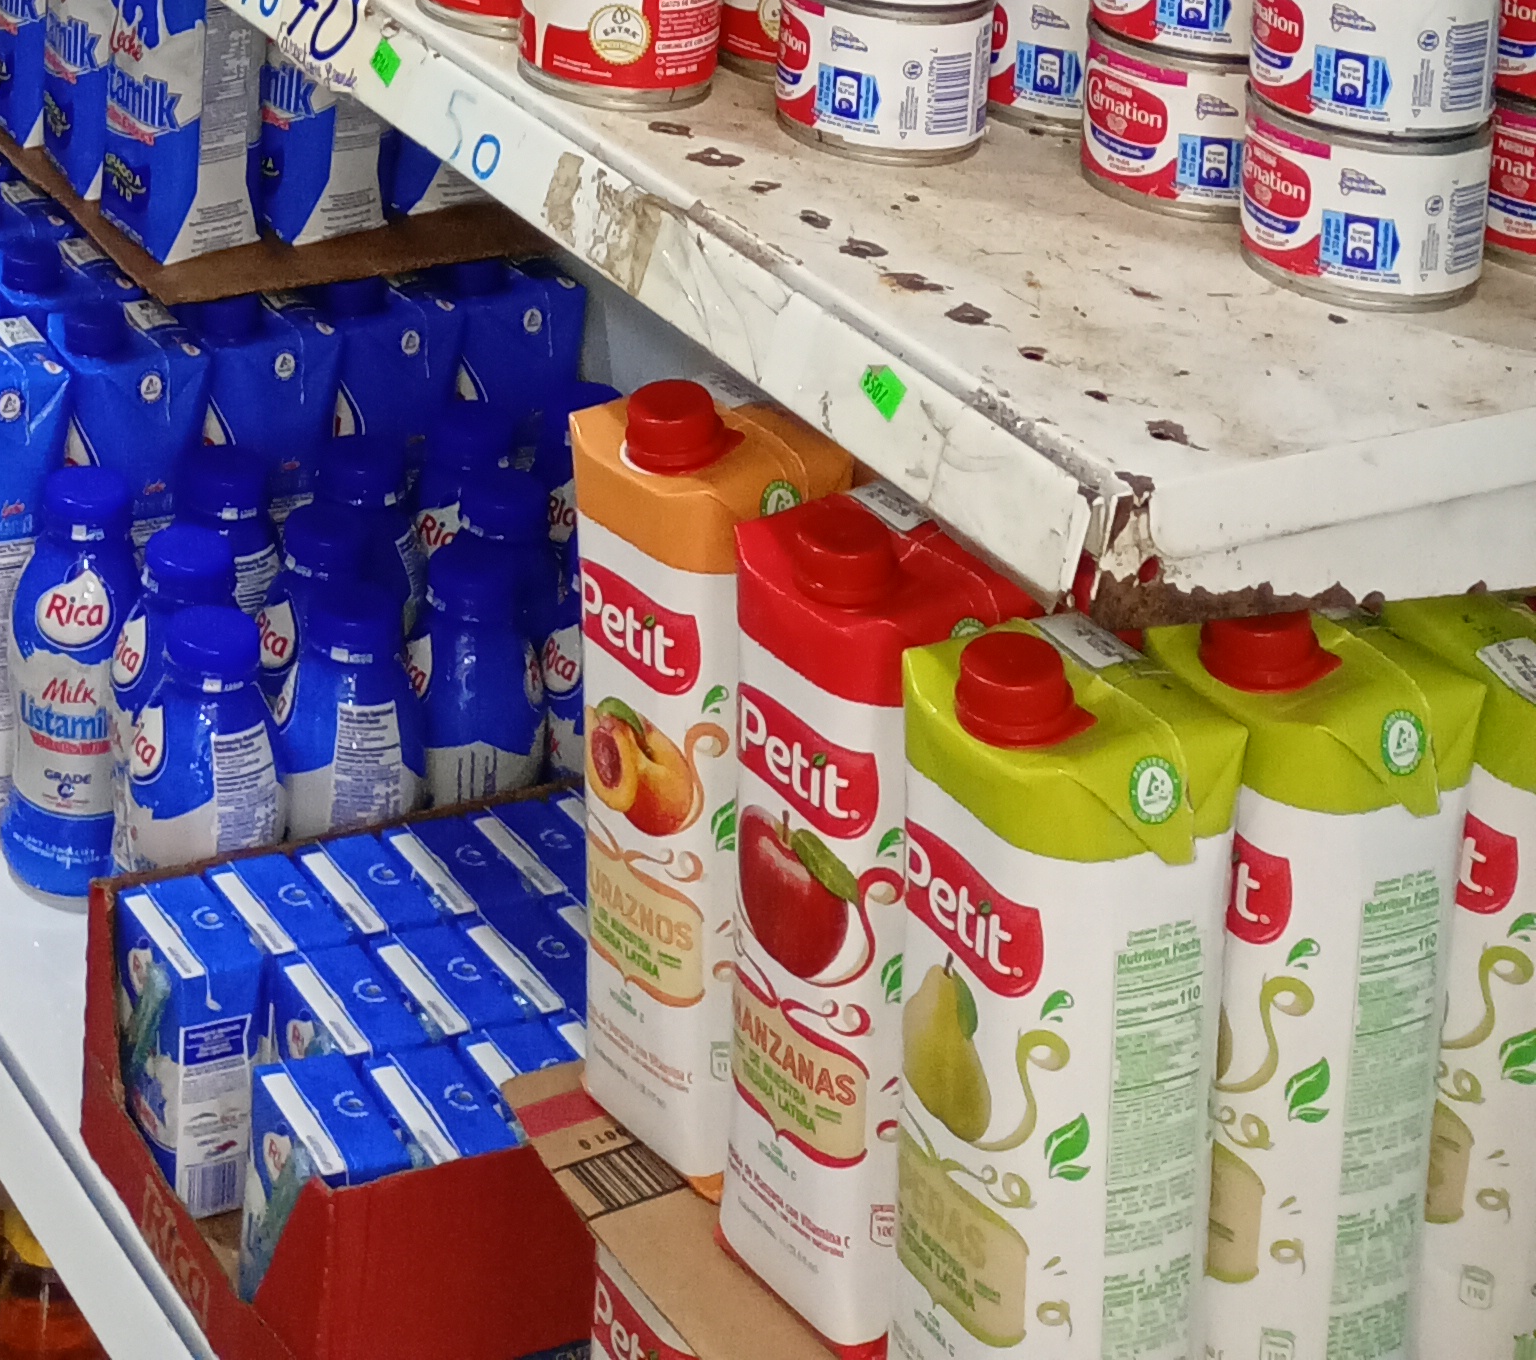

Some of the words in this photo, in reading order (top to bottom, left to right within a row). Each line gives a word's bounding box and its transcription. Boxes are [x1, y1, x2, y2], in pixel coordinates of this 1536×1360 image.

[107, 69, 183, 131] tamilk
[1088, 75, 1162, 130] Carnation
[45, 593, 104, 627] Rica
[581, 579, 686, 677] Petit
[543, 633, 577, 682] Rica
[42, 677, 97, 705] Milk
[44, 769, 92, 785] GRADE
[739, 705, 860, 821] Petit
[905, 844, 1024, 978] Petit
[1418, 933, 1438, 953] 110
[1179, 984, 1202, 1005] 110
